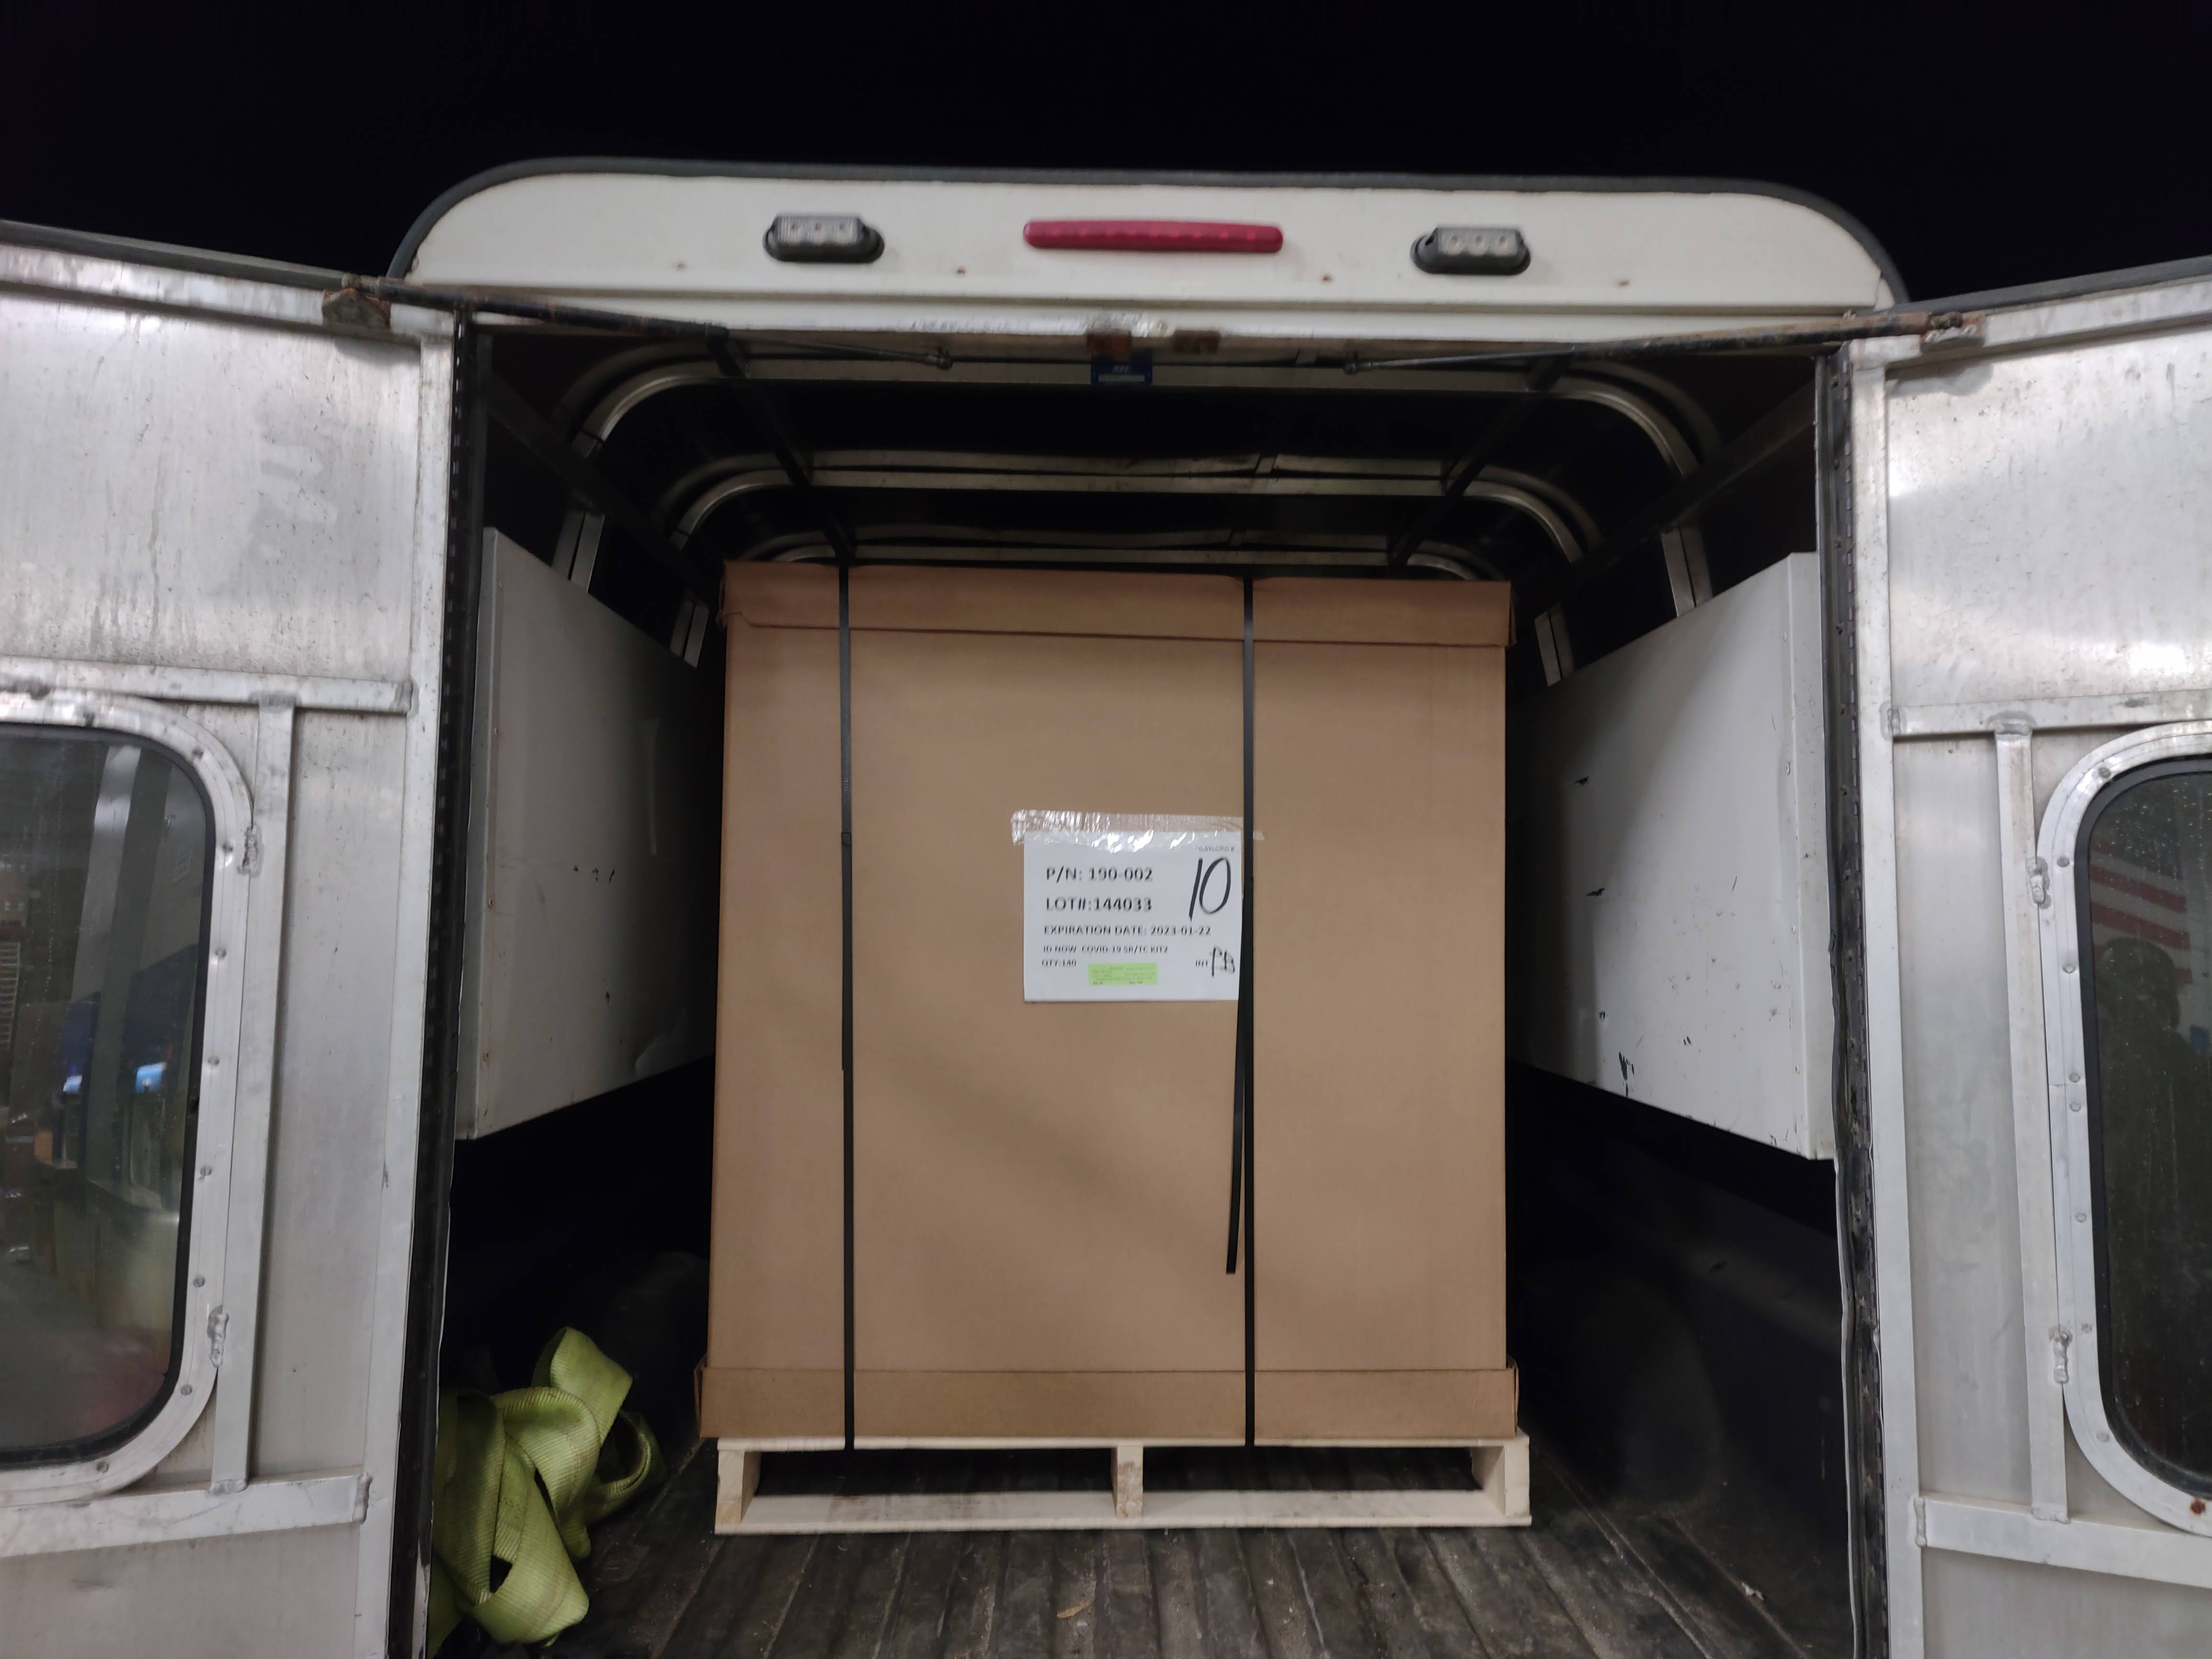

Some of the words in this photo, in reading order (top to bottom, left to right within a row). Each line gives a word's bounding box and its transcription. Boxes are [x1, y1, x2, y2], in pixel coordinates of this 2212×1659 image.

[1046, 865, 1082, 883] P/N:
[1088, 866, 1153, 882] 190-002
[1188, 857, 1231, 921] 10
[1046, 896, 1152, 911] LOT#:144033
[1044, 925, 1111, 936] EXPIRATION
[1115, 925, 1147, 936] DATE:
[1150, 925, 1211, 936] 2023-01-22
[1043, 945, 1052, 954] ID
[1055, 945, 1077, 954] NOW
[1081, 945, 1121, 954] COVID-19
